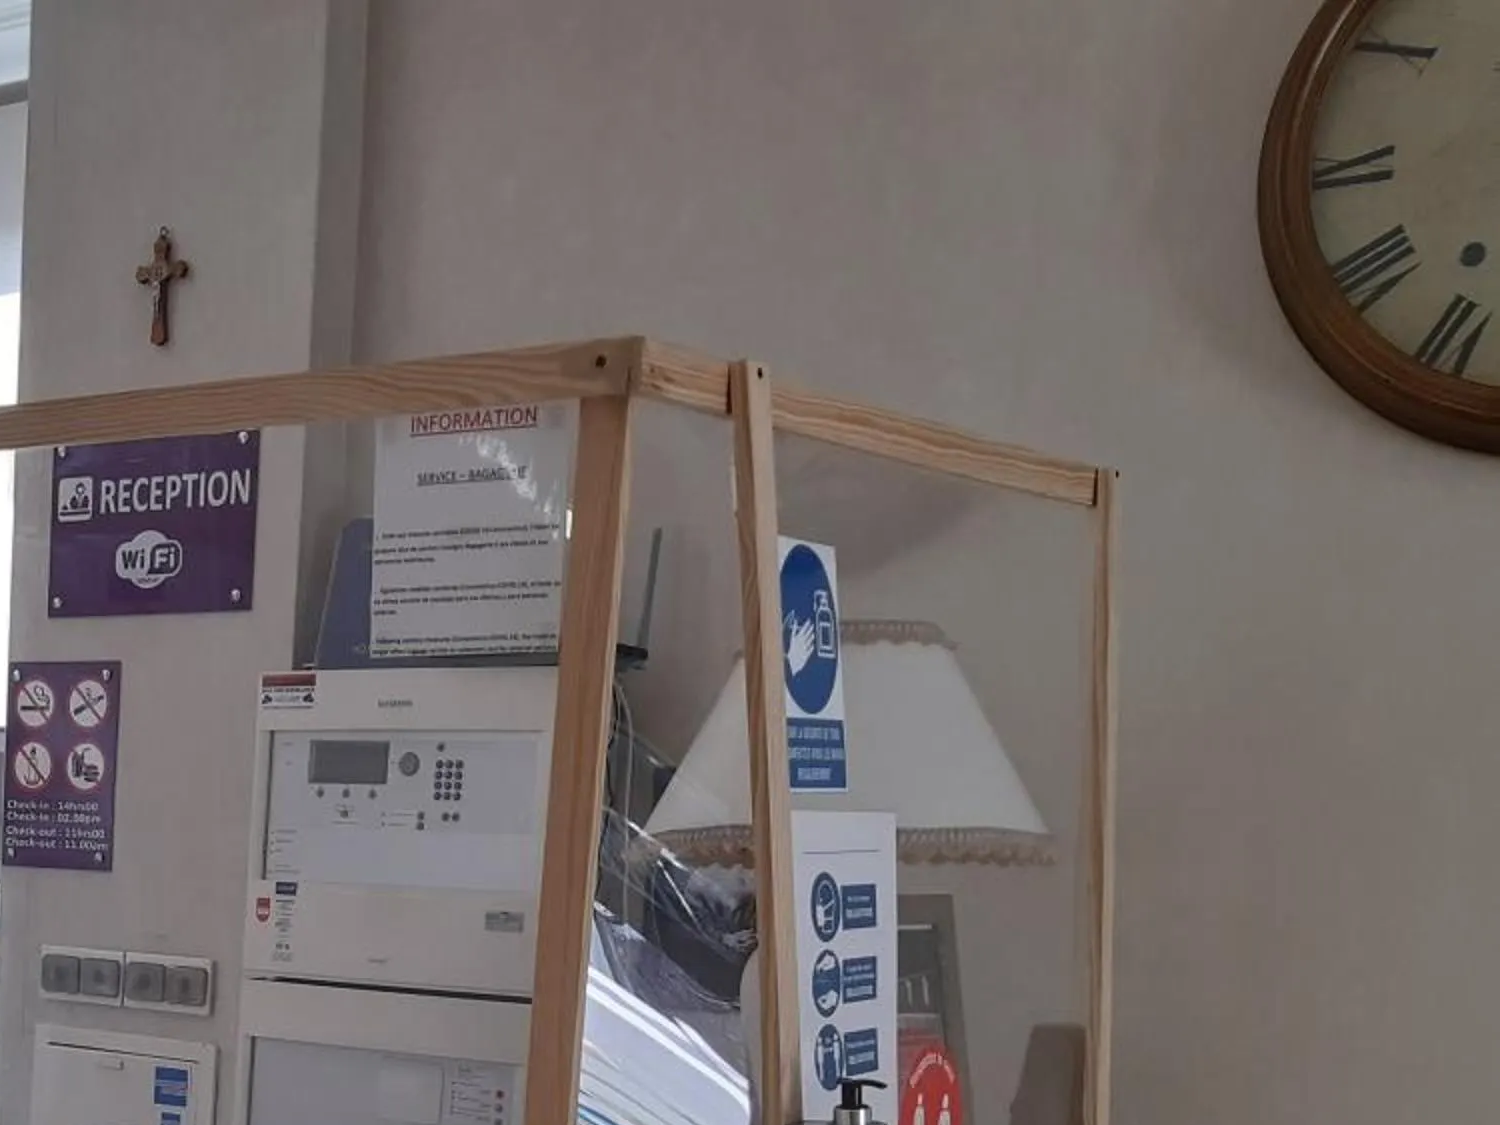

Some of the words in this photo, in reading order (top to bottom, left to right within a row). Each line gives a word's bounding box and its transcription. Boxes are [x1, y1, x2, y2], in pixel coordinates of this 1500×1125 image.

[411, 406, 538, 433] INFORMATION
[417, 469, 457, 484] SERVICE
[100, 468, 250, 515] RECEPTION
